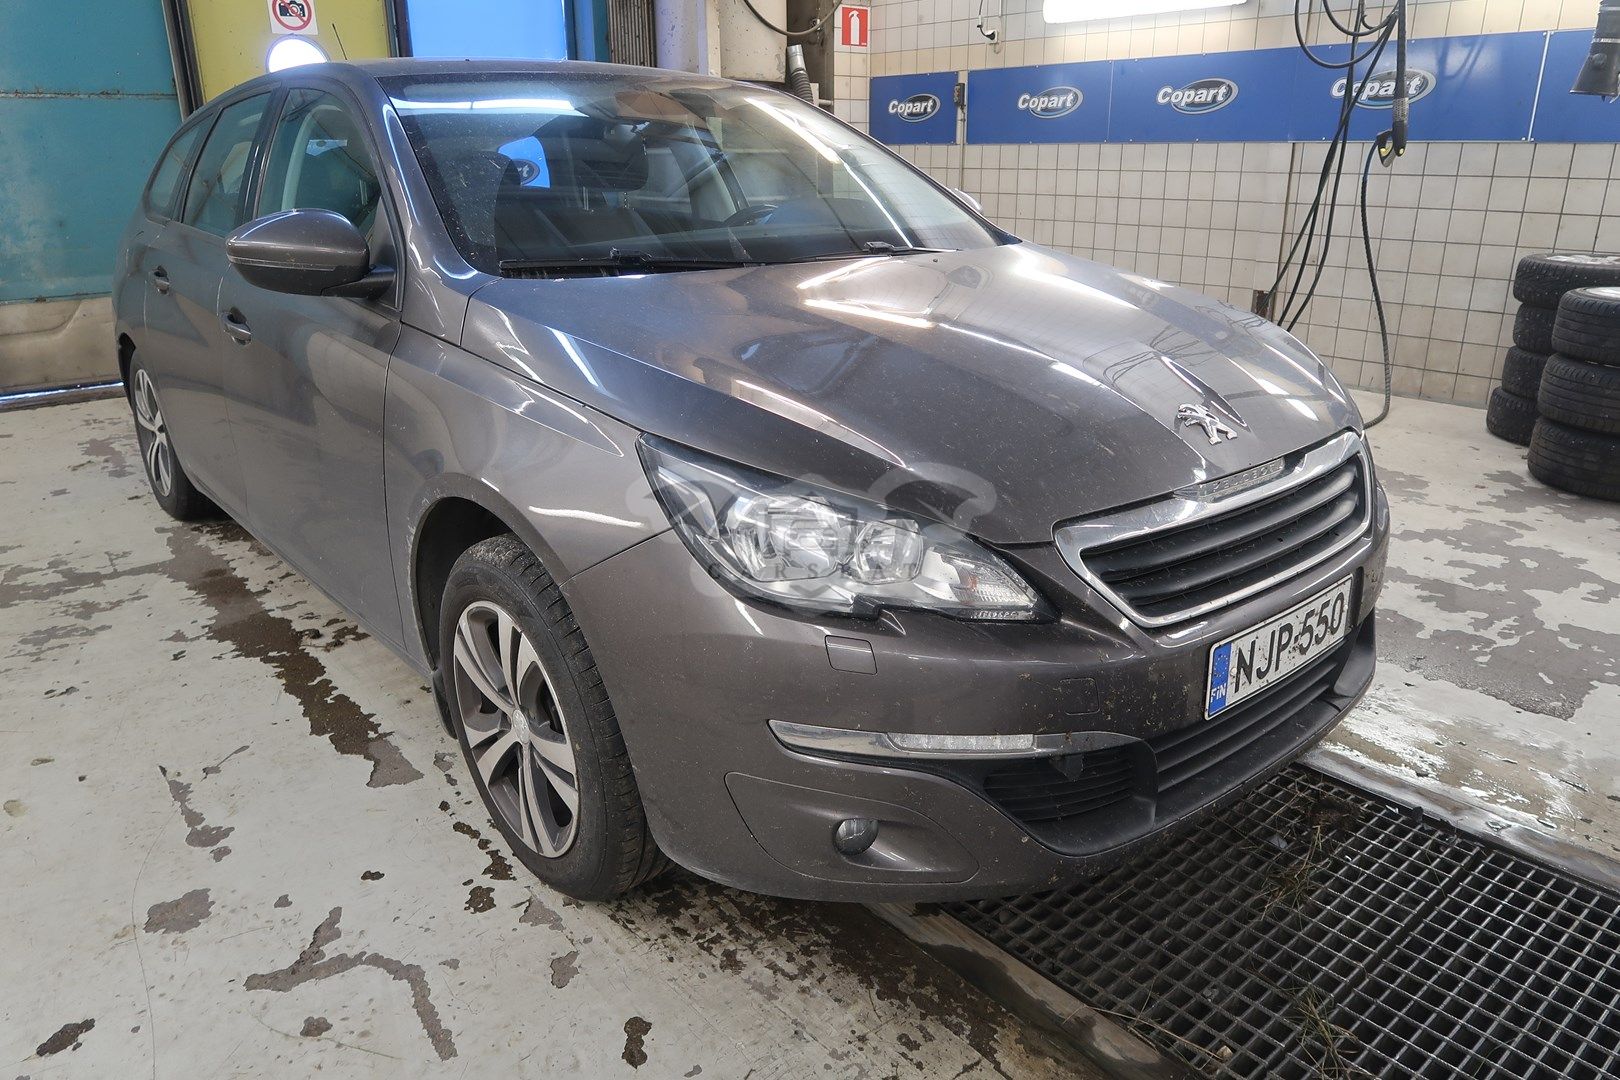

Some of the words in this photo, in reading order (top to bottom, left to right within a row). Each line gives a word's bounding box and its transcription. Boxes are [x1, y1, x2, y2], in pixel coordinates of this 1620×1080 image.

[1157, 84, 1227, 107] Copart
[1331, 76, 1421, 101] Copat
[888, 98, 935, 118] Copart
[1018, 92, 1075, 111] Copart
[1234, 592, 1345, 694] NJP-550
[1210, 682, 1227, 703] FIN
